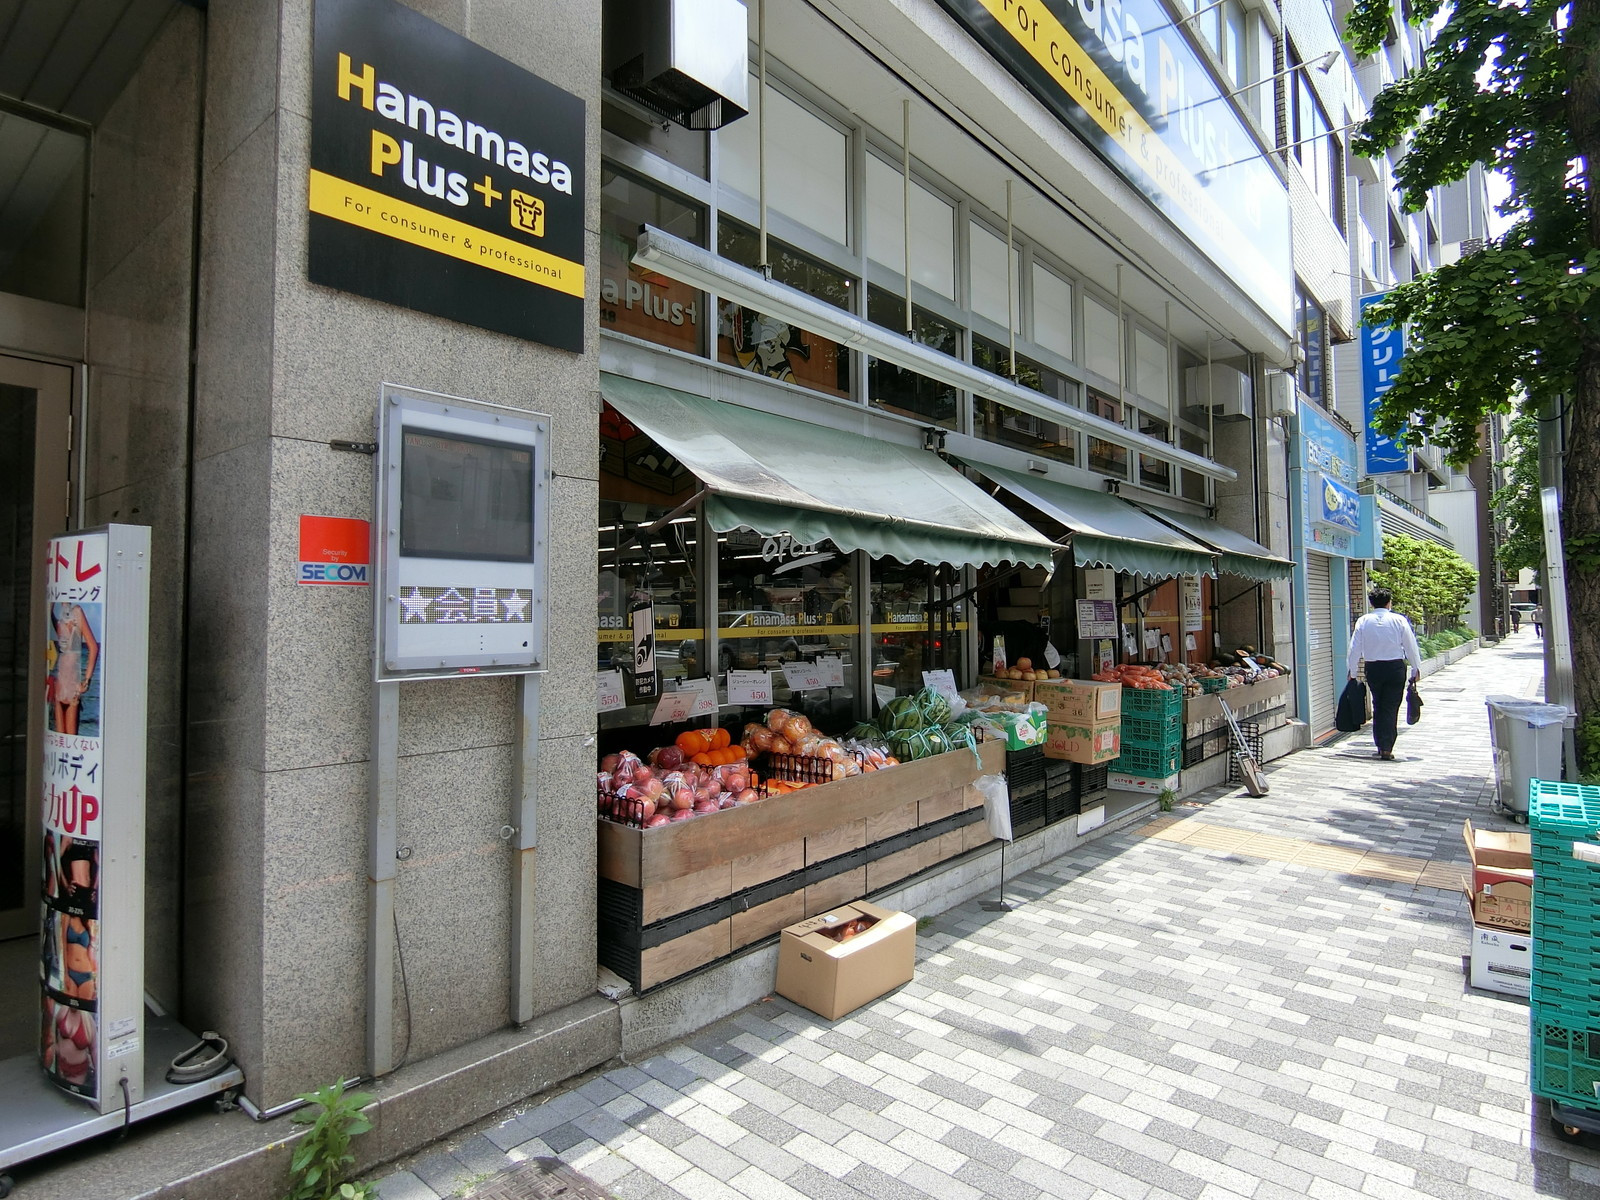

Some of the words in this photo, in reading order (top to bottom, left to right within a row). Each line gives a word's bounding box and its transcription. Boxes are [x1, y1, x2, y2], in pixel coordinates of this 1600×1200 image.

[1050, 41, 1133, 142] consumer
[1140, 133, 1149, 160] &
[338, 51, 573, 197] Hanamasa
[344, 195, 373, 215] For
[381, 209, 456, 244] consumer
[463, 237, 473, 250] &
[480, 243, 562, 280] professional
[601, 278, 619, 306] a
[322, 548, 348, 557] Security
[46, 541, 102, 584] トレ
[302, 564, 366, 581] SECOM
[598, 613, 624, 628] asa
[746, 613, 796, 626] Hanamasa
[796, 627, 825, 635] professional
[601, 693, 619, 706] 550
[751, 690, 767, 700] 450
[698, 699, 713, 710] 398
[670, 709, 686, 719] 550
[50, 734, 99, 751] 美しくない
[1045, 738, 1080, 752] GOLD
[46, 752, 98, 784] リボディ
[44, 783, 99, 836] 力UP
[1505, 903, 1513, 912] A
